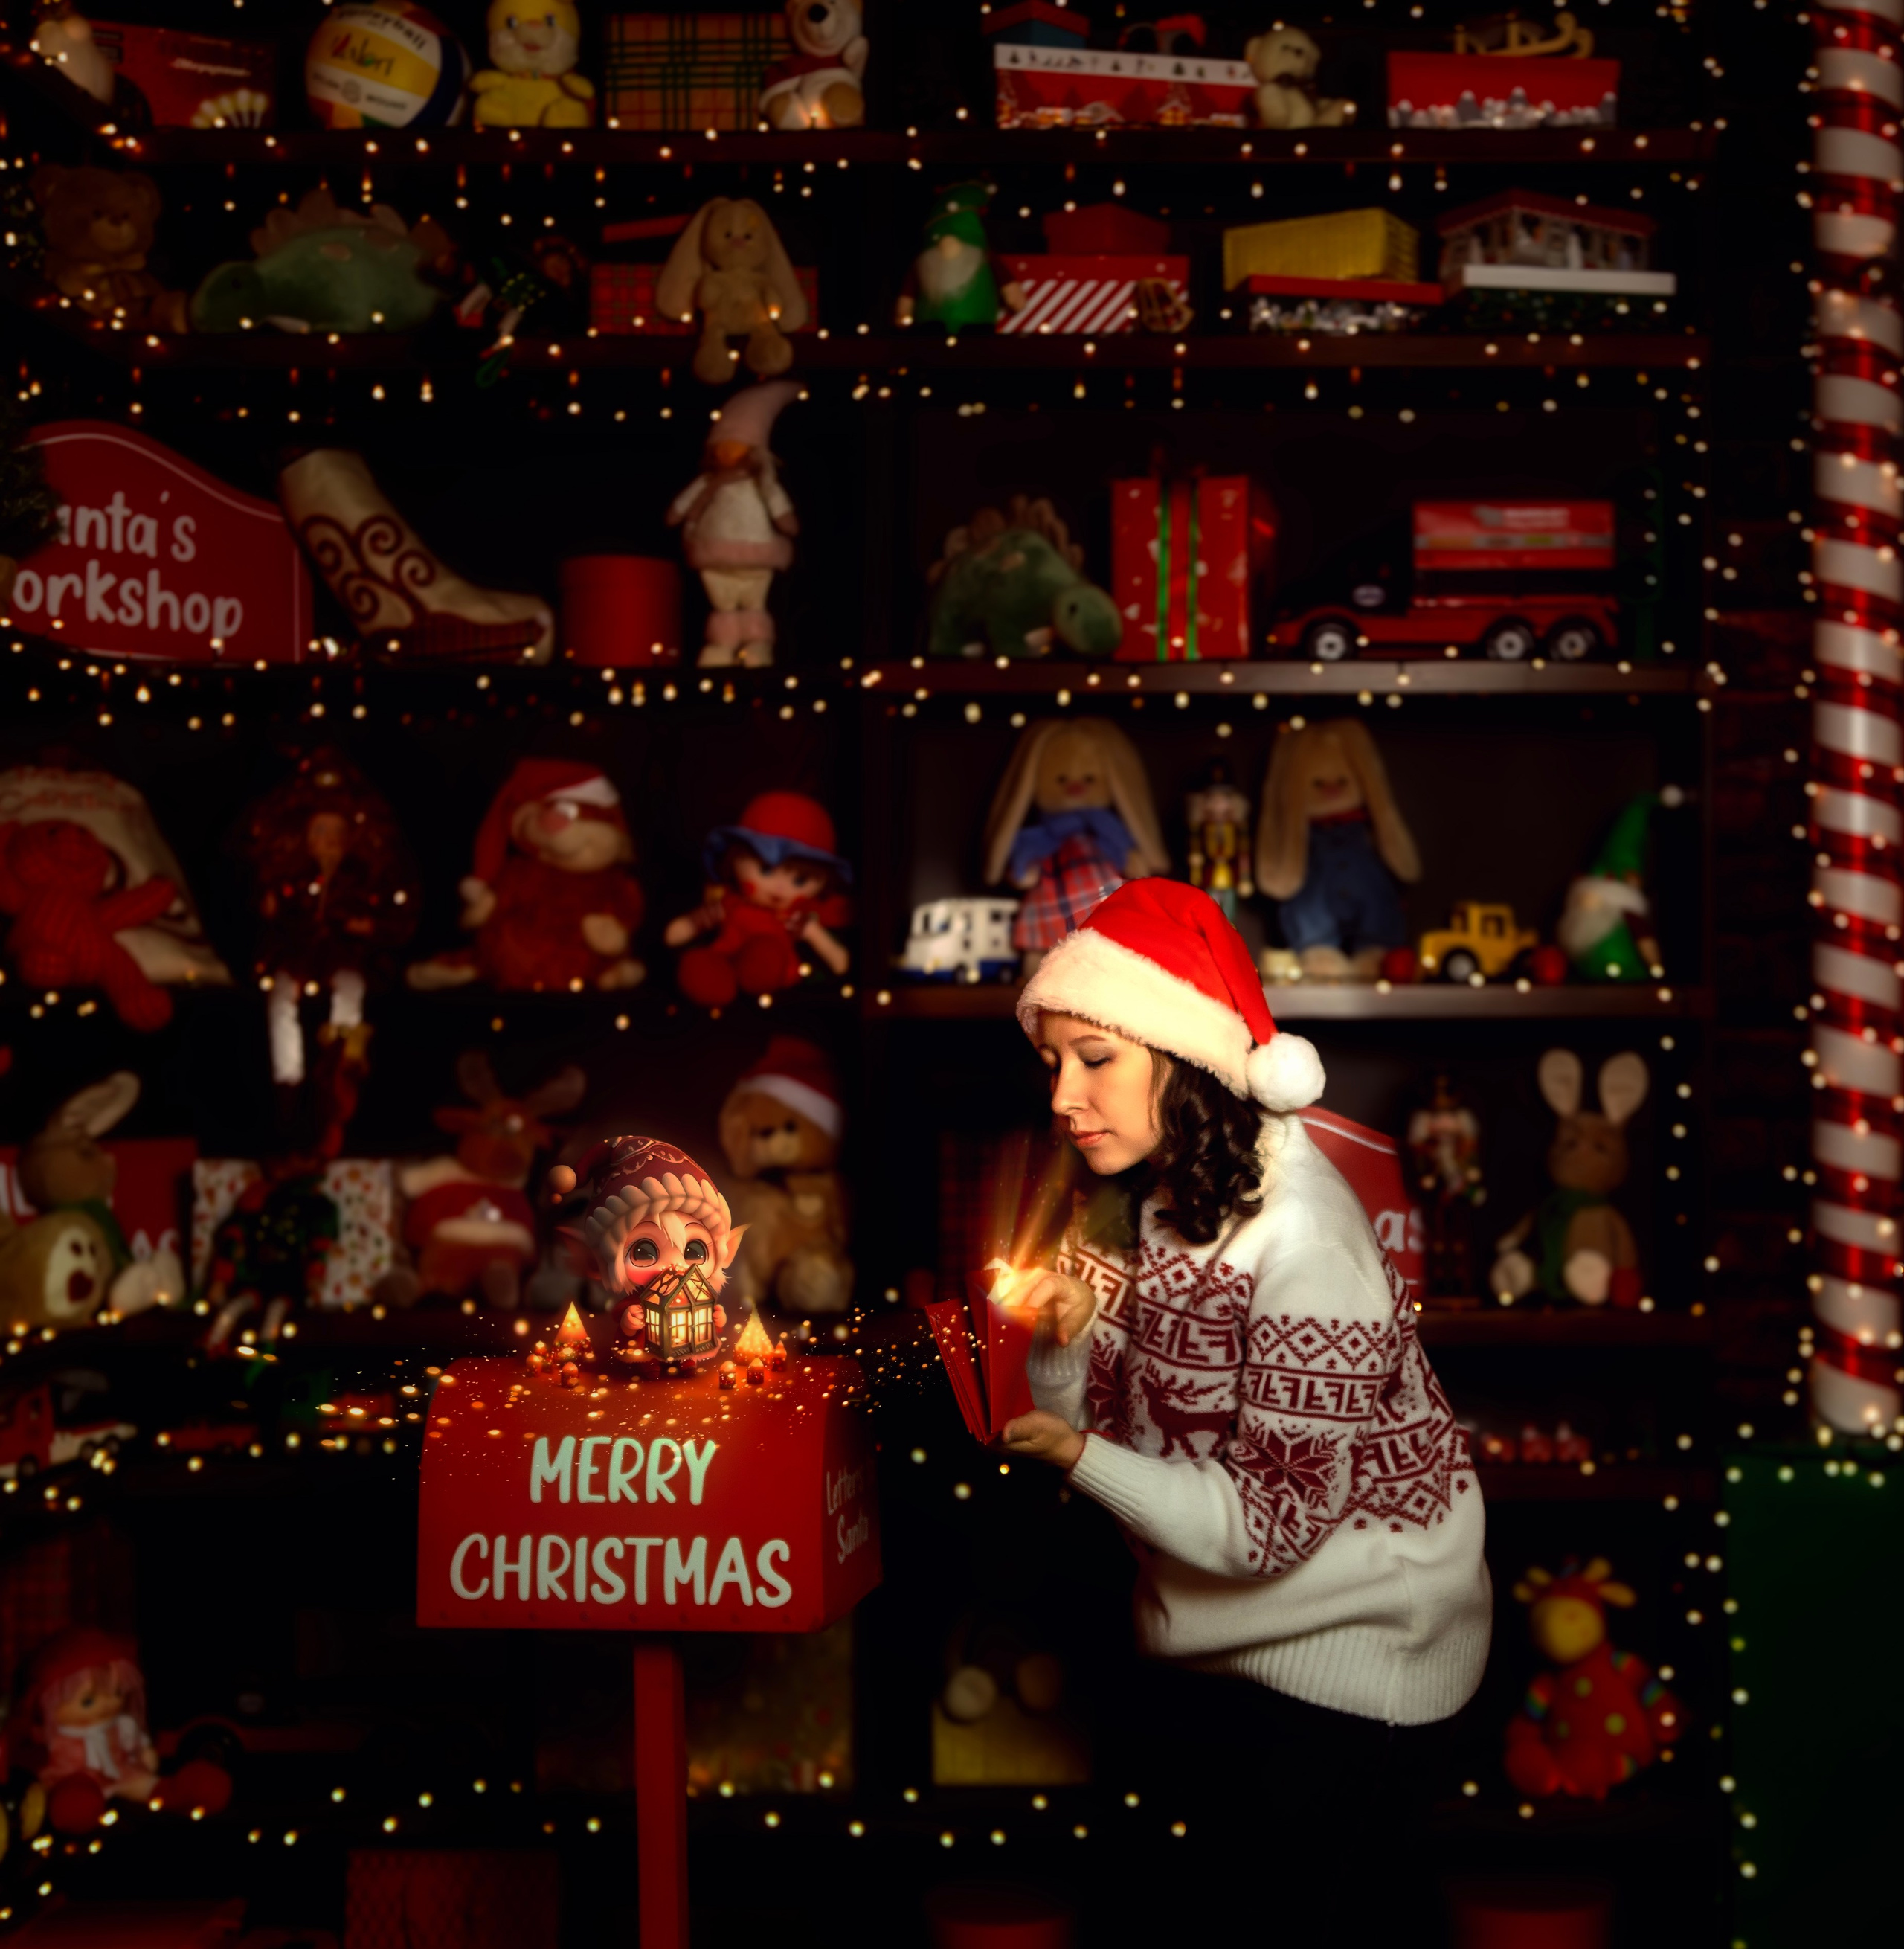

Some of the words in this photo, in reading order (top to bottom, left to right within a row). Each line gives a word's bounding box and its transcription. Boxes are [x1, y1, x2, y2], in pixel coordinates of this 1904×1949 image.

[54, 489, 197, 563] anta's
[12, 557, 244, 657] orkshop
[529, 1435, 718, 1506] MERRY
[449, 1532, 793, 1608] CHRISTMAS
